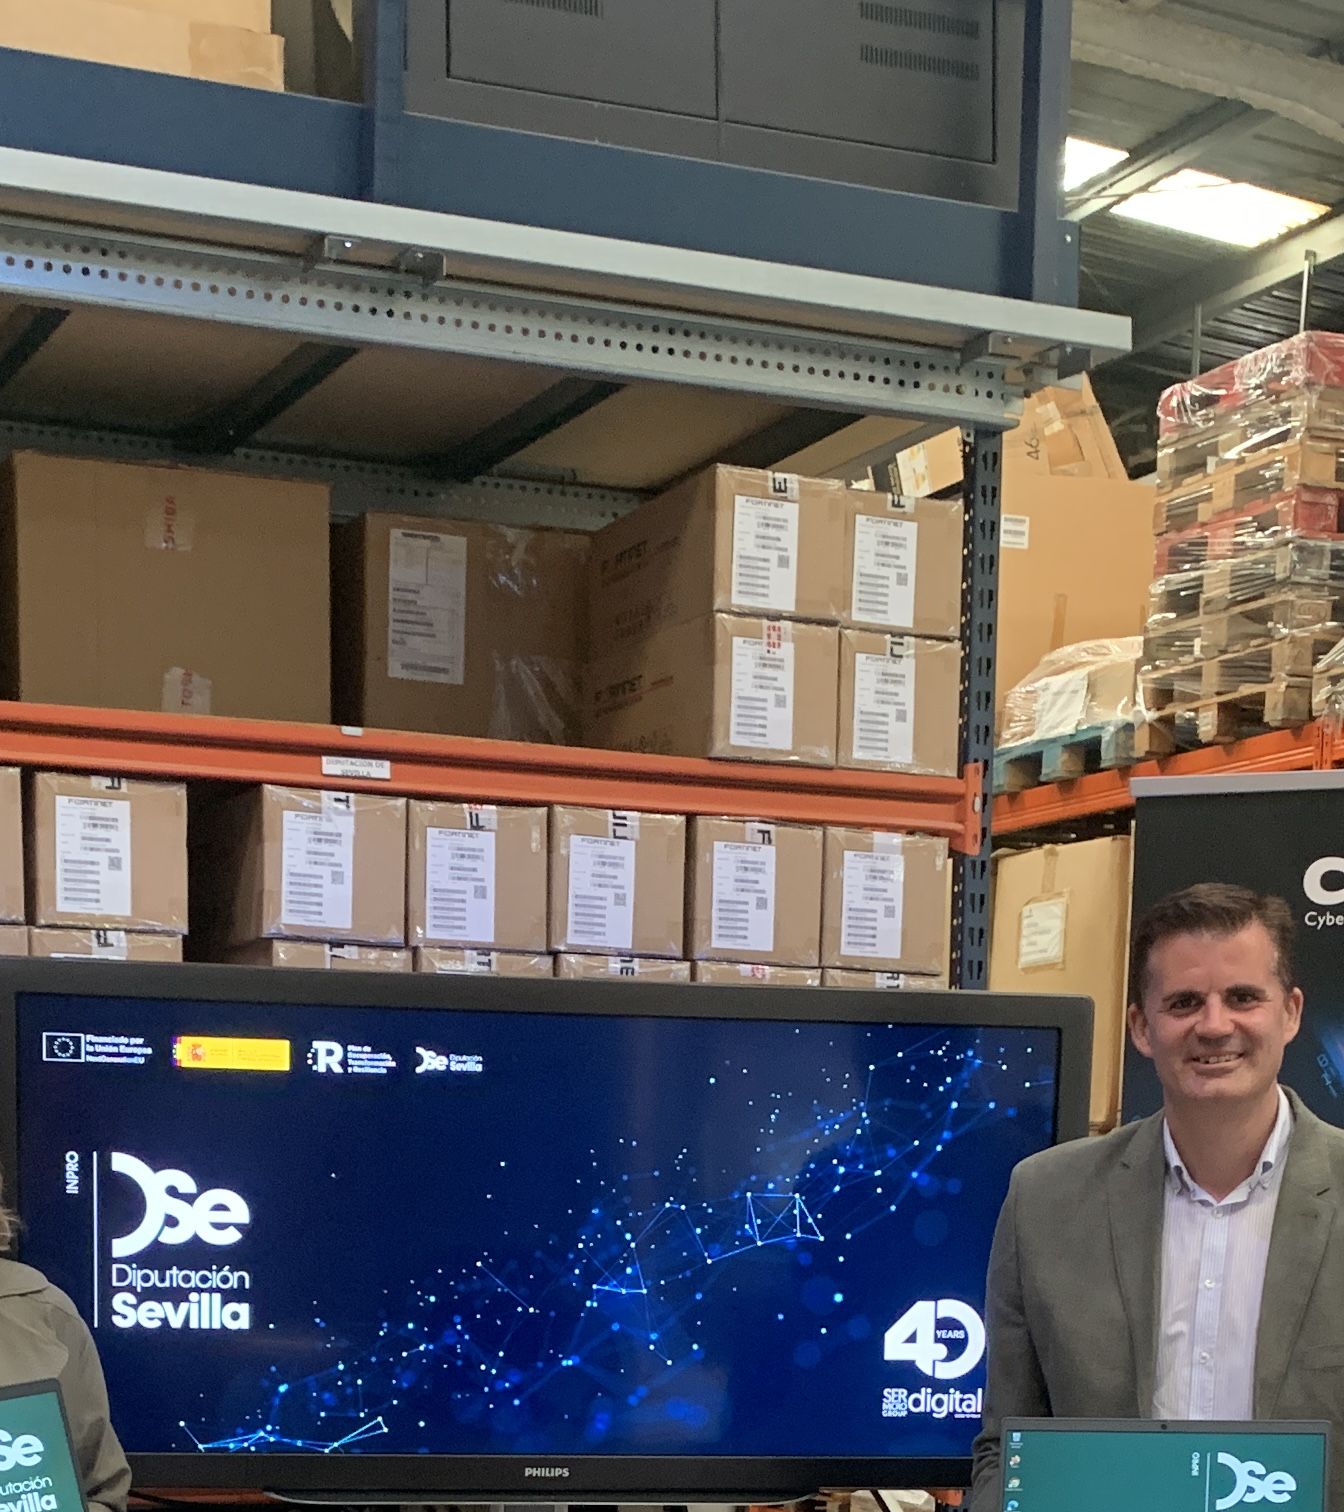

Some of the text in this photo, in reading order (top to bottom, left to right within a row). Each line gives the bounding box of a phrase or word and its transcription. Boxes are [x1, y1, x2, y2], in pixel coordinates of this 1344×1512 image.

[67, 798, 113, 808] FORTINET
[449, 1061, 483, 1073] Sevilla
[65, 1150, 79, 1194] INPRO
[111, 1263, 250, 1293] Diputación
[111, 1291, 250, 1330] Sevilla
[883, 1298, 986, 1380] 40
[936, 1329, 965, 1339] YEARS
[882, 1387, 983, 1419] SER digital
[524, 1467, 570, 1477] PHILIPS
